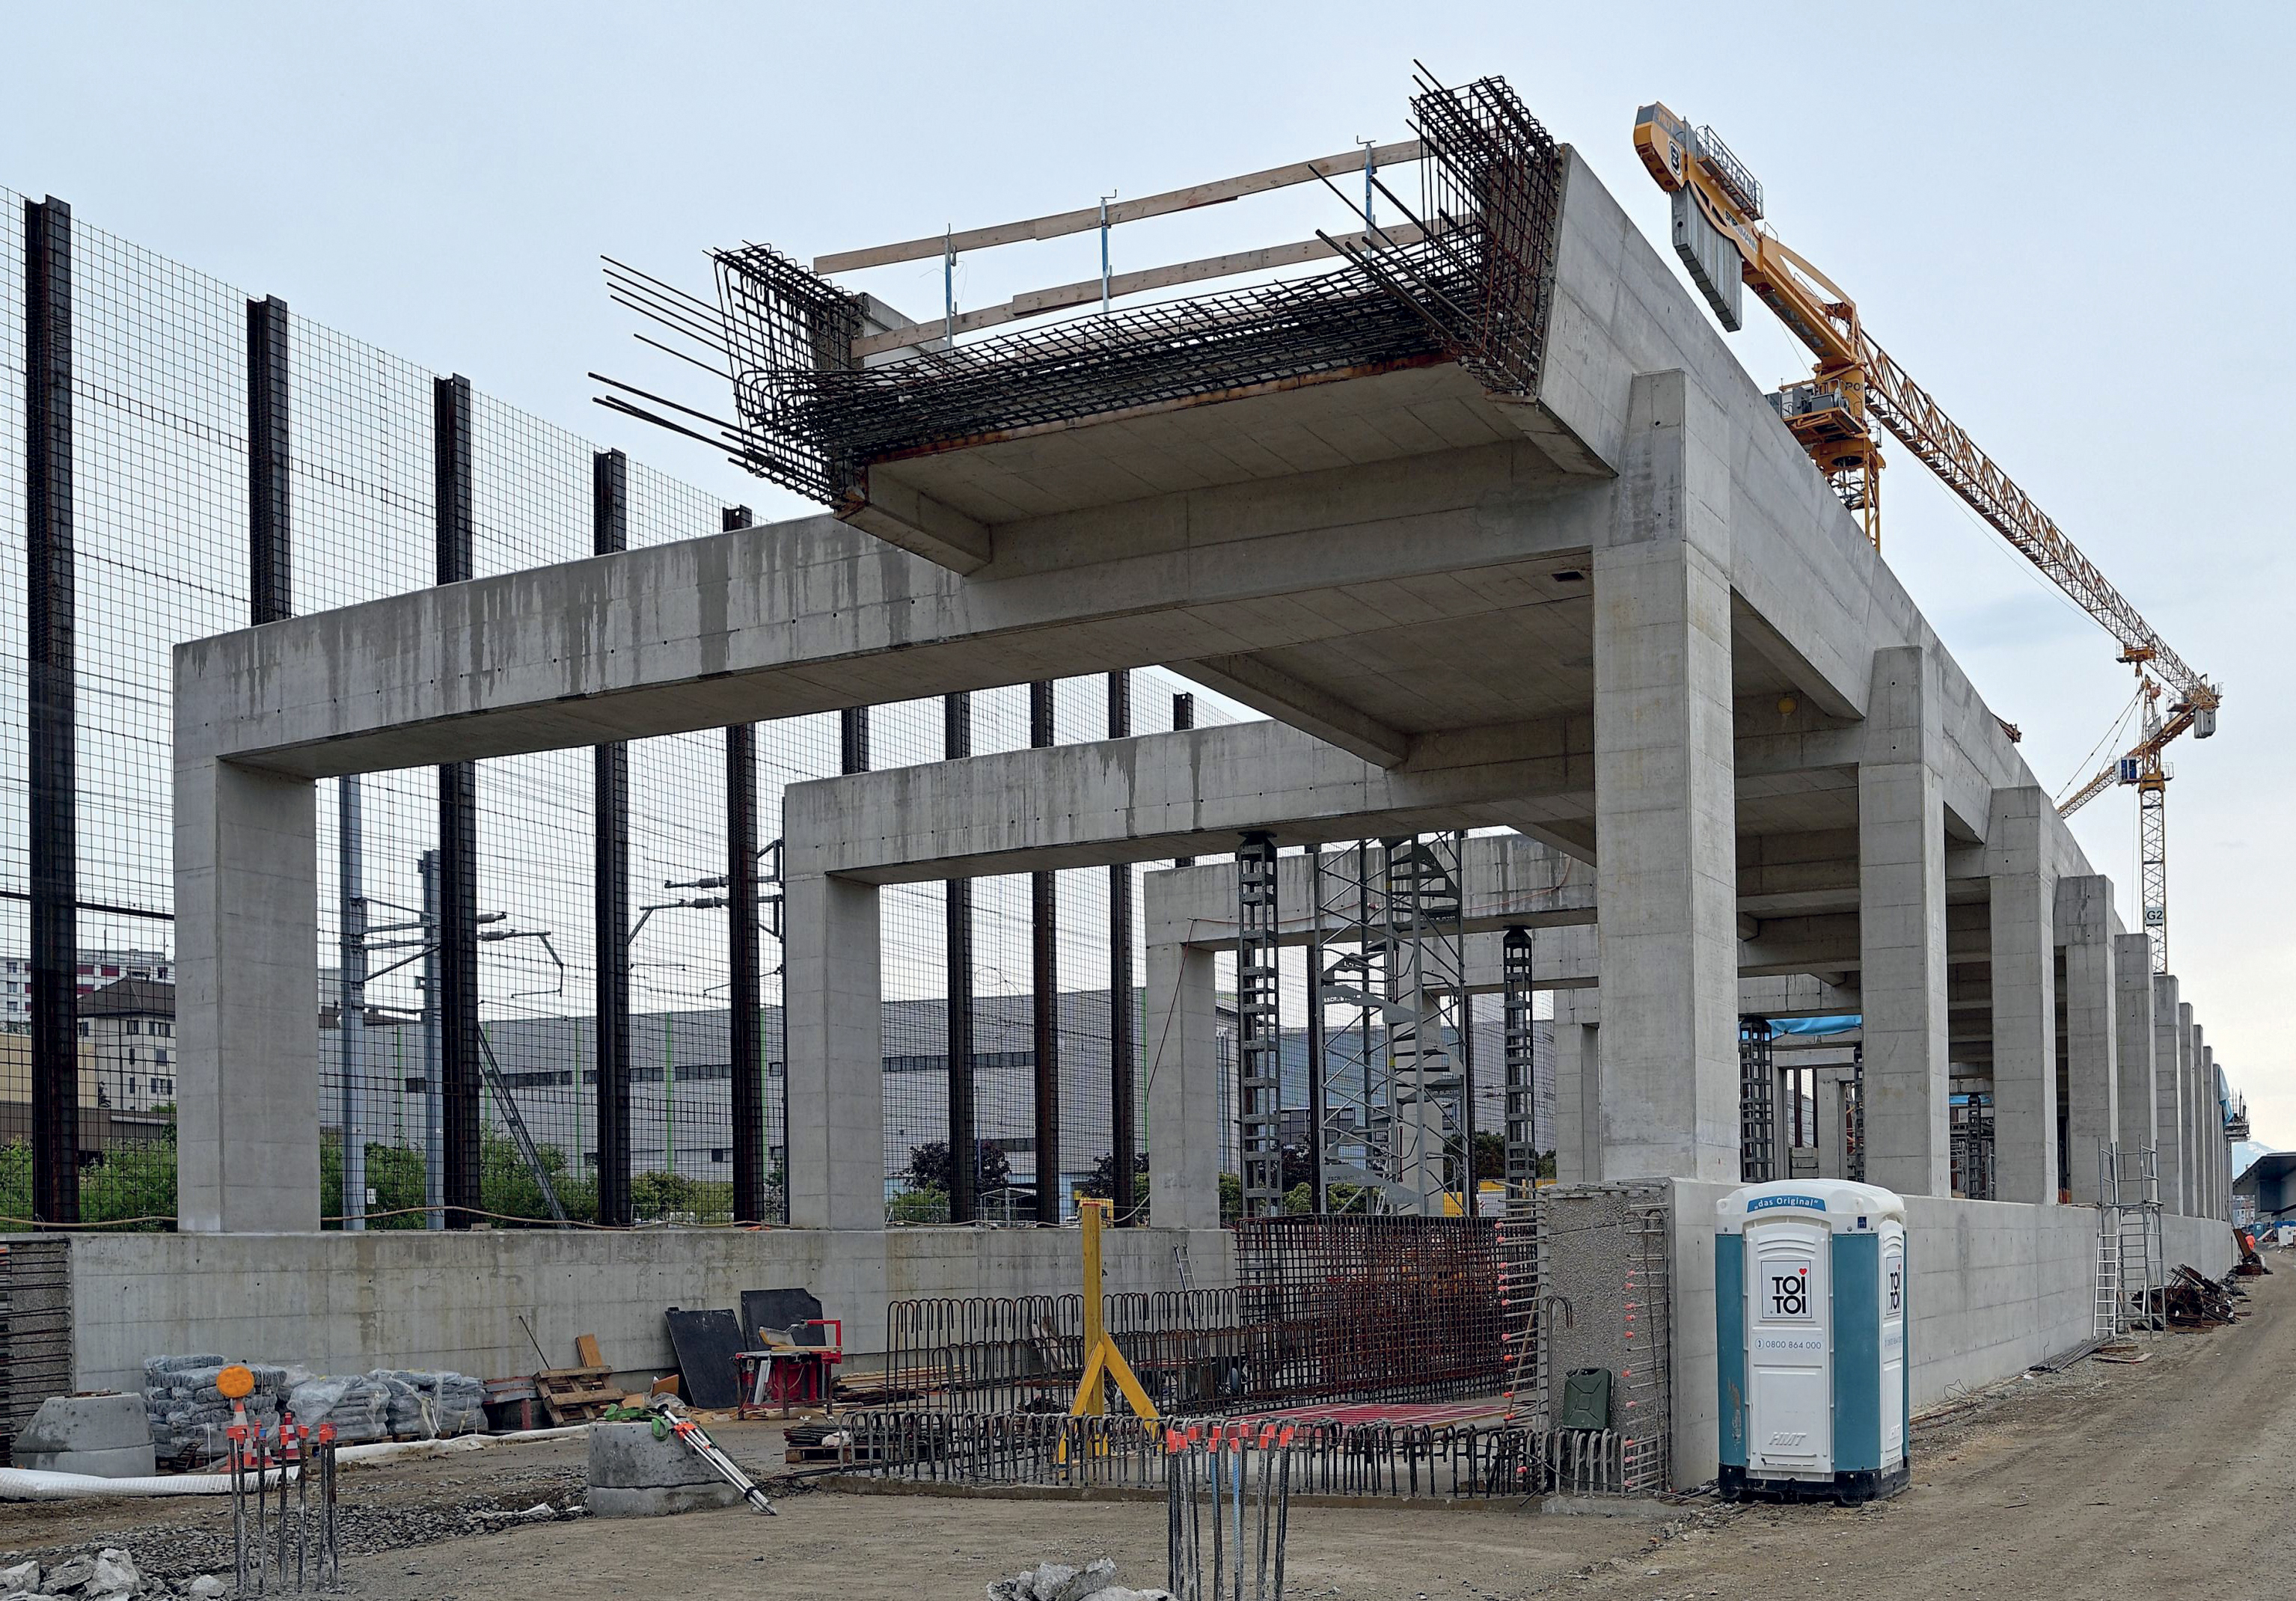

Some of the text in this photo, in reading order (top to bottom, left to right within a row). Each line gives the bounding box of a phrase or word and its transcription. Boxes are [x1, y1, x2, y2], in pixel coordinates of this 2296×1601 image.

[2147, 910, 2163, 920] G2
[1772, 1276, 1806, 1294] TOI
[1890, 1271, 1900, 1291] TOI
[1772, 1295, 1807, 1314] TOI
[1890, 1291, 1900, 1310] TOI
[1766, 1340, 1822, 1350] 0800 864 000
[1769, 1432, 1807, 1446] HMT
